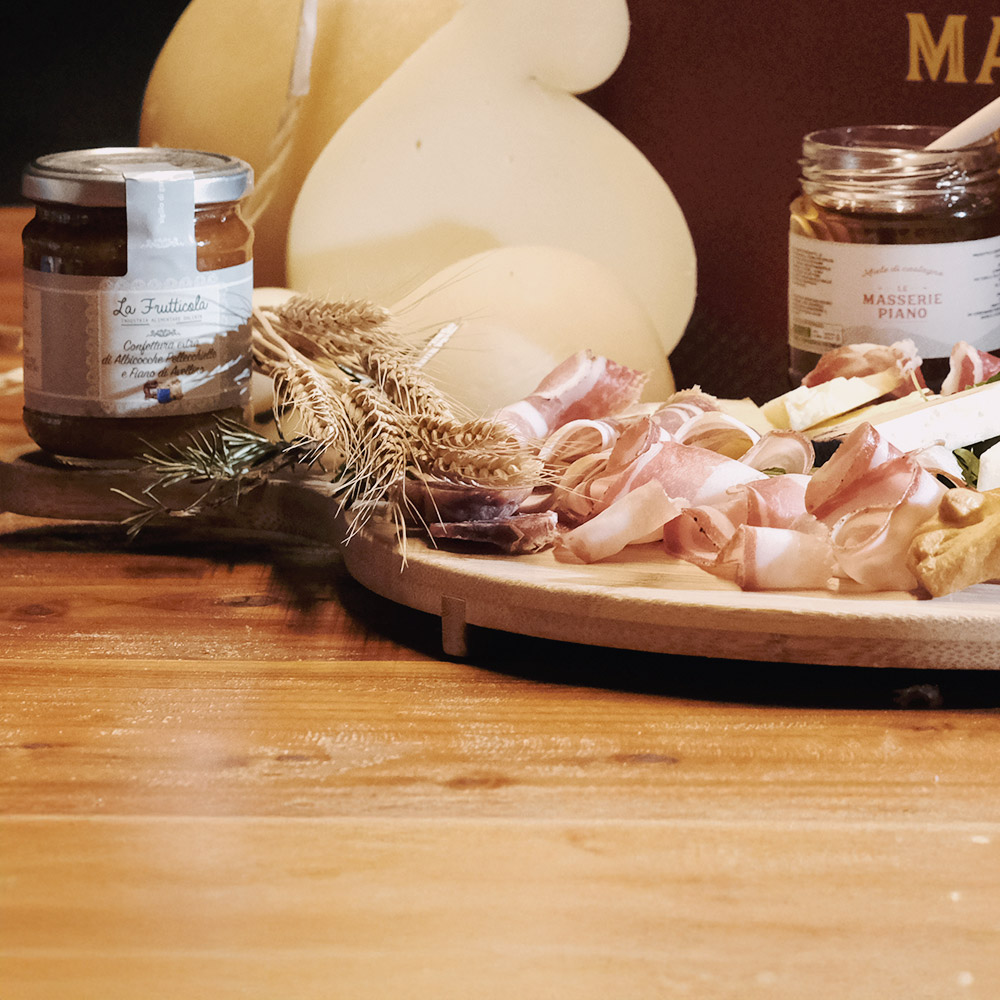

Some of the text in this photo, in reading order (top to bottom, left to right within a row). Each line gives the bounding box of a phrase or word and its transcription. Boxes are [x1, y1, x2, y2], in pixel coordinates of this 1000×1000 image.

[862, 293, 943, 305] MASSERIE
[113, 294, 208, 318] La Frutticola
[878, 307, 927, 319] PIANO
[123, 339, 174, 356] Confettura
[101, 353, 113, 365] di
[114, 352, 164, 365] Albicocche
[129, 367, 155, 379] Fiano
[157, 367, 168, 378] di
